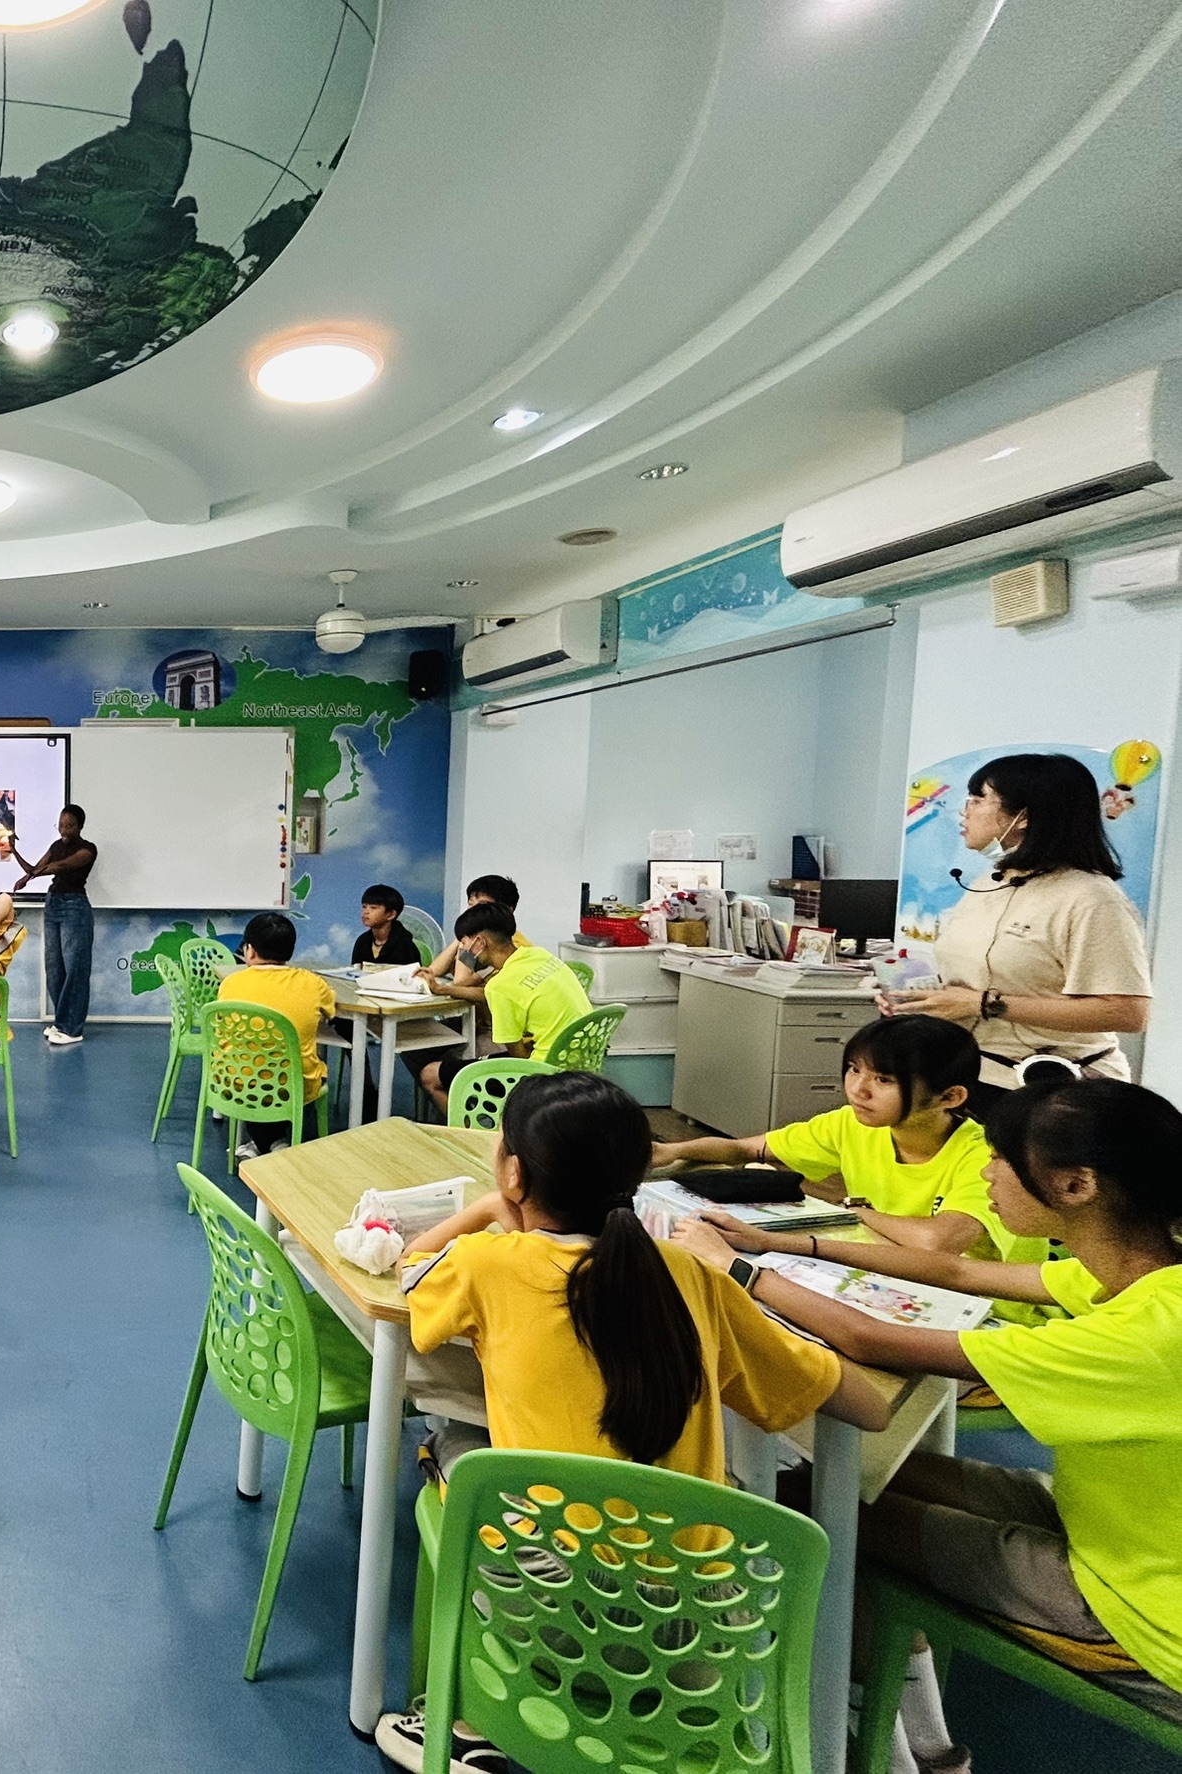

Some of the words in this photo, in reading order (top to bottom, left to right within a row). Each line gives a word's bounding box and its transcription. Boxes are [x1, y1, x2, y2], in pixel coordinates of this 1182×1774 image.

[93, 691, 151, 708] Europe
[243, 703, 323, 718] Northeast
[325, 703, 362, 718] Asia
